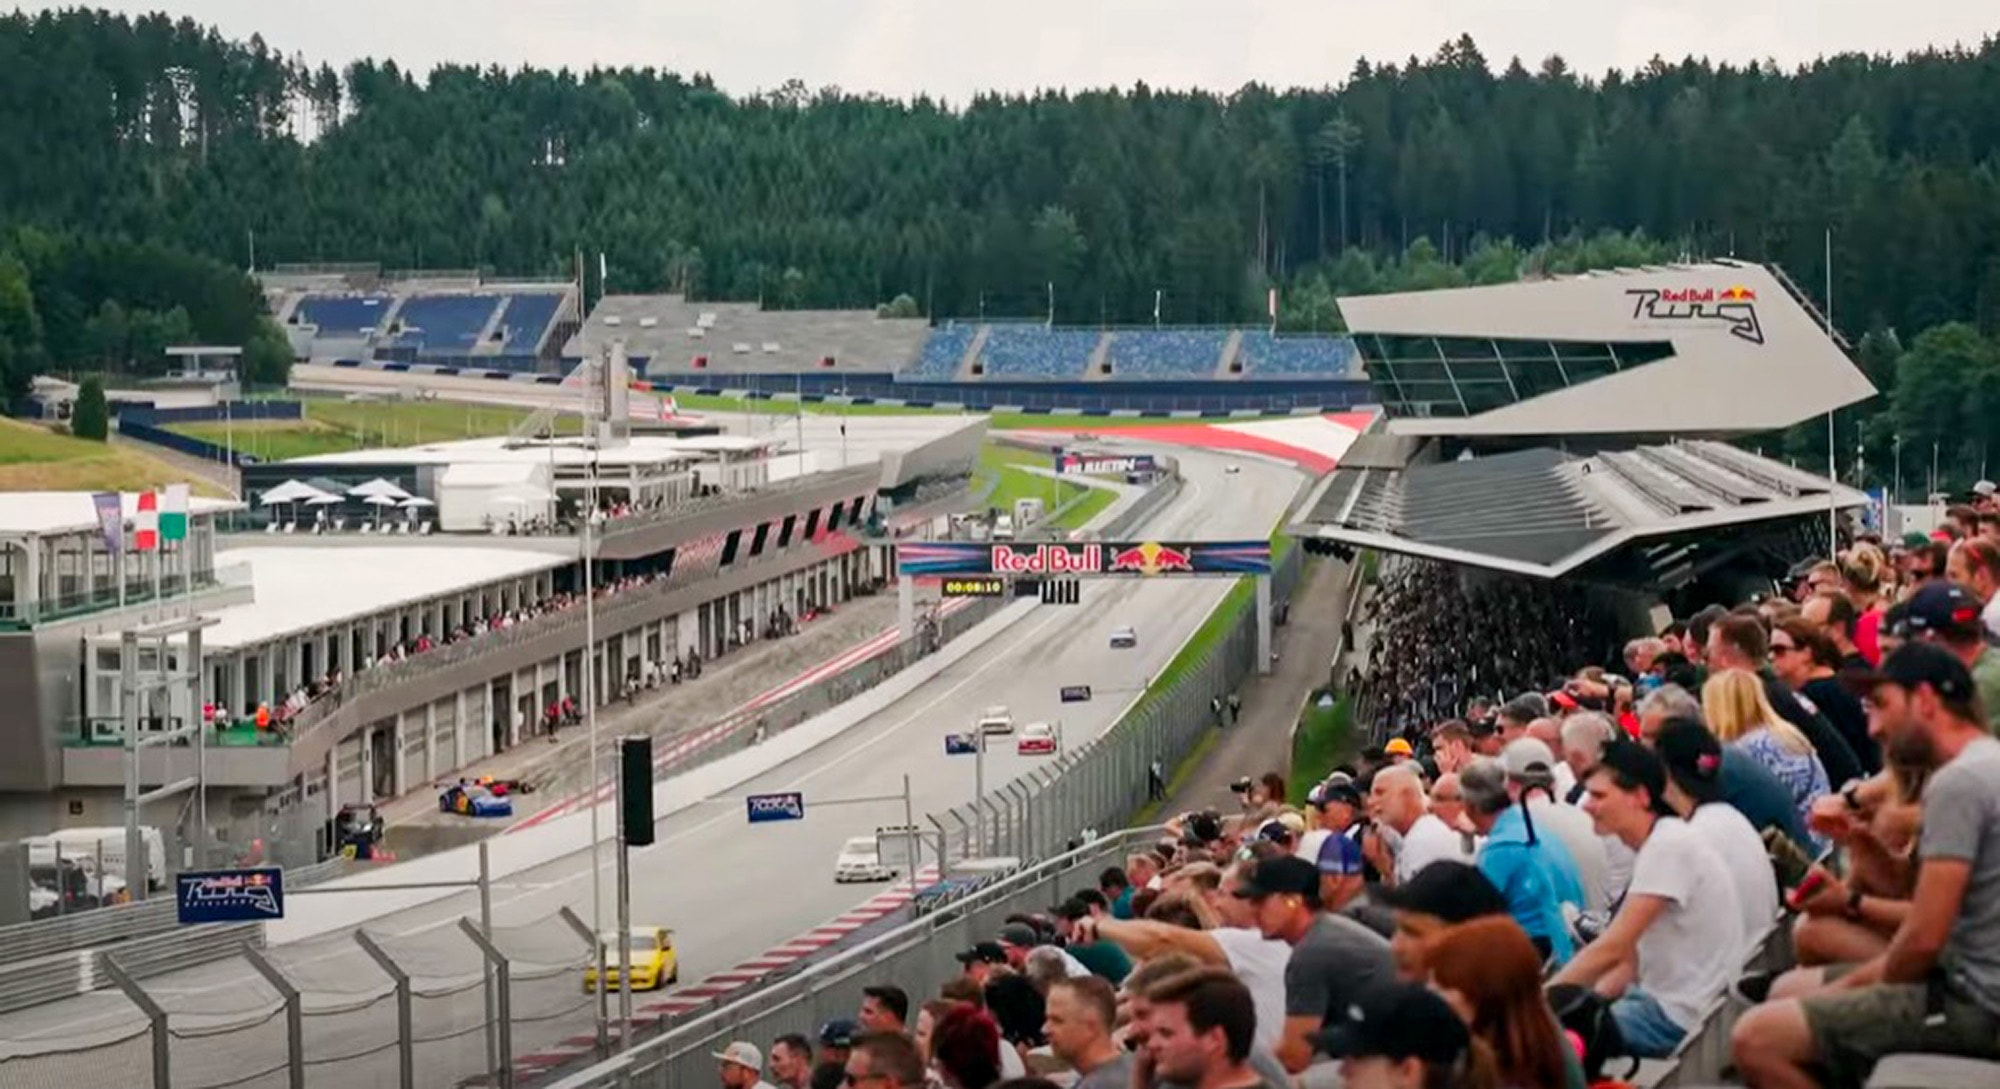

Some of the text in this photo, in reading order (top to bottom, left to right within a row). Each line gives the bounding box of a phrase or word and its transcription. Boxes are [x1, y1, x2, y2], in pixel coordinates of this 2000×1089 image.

[1662, 288, 1713, 301] Red Bull
[1625, 289, 1764, 344] Ring
[992, 544, 1102, 572] Red Bull
